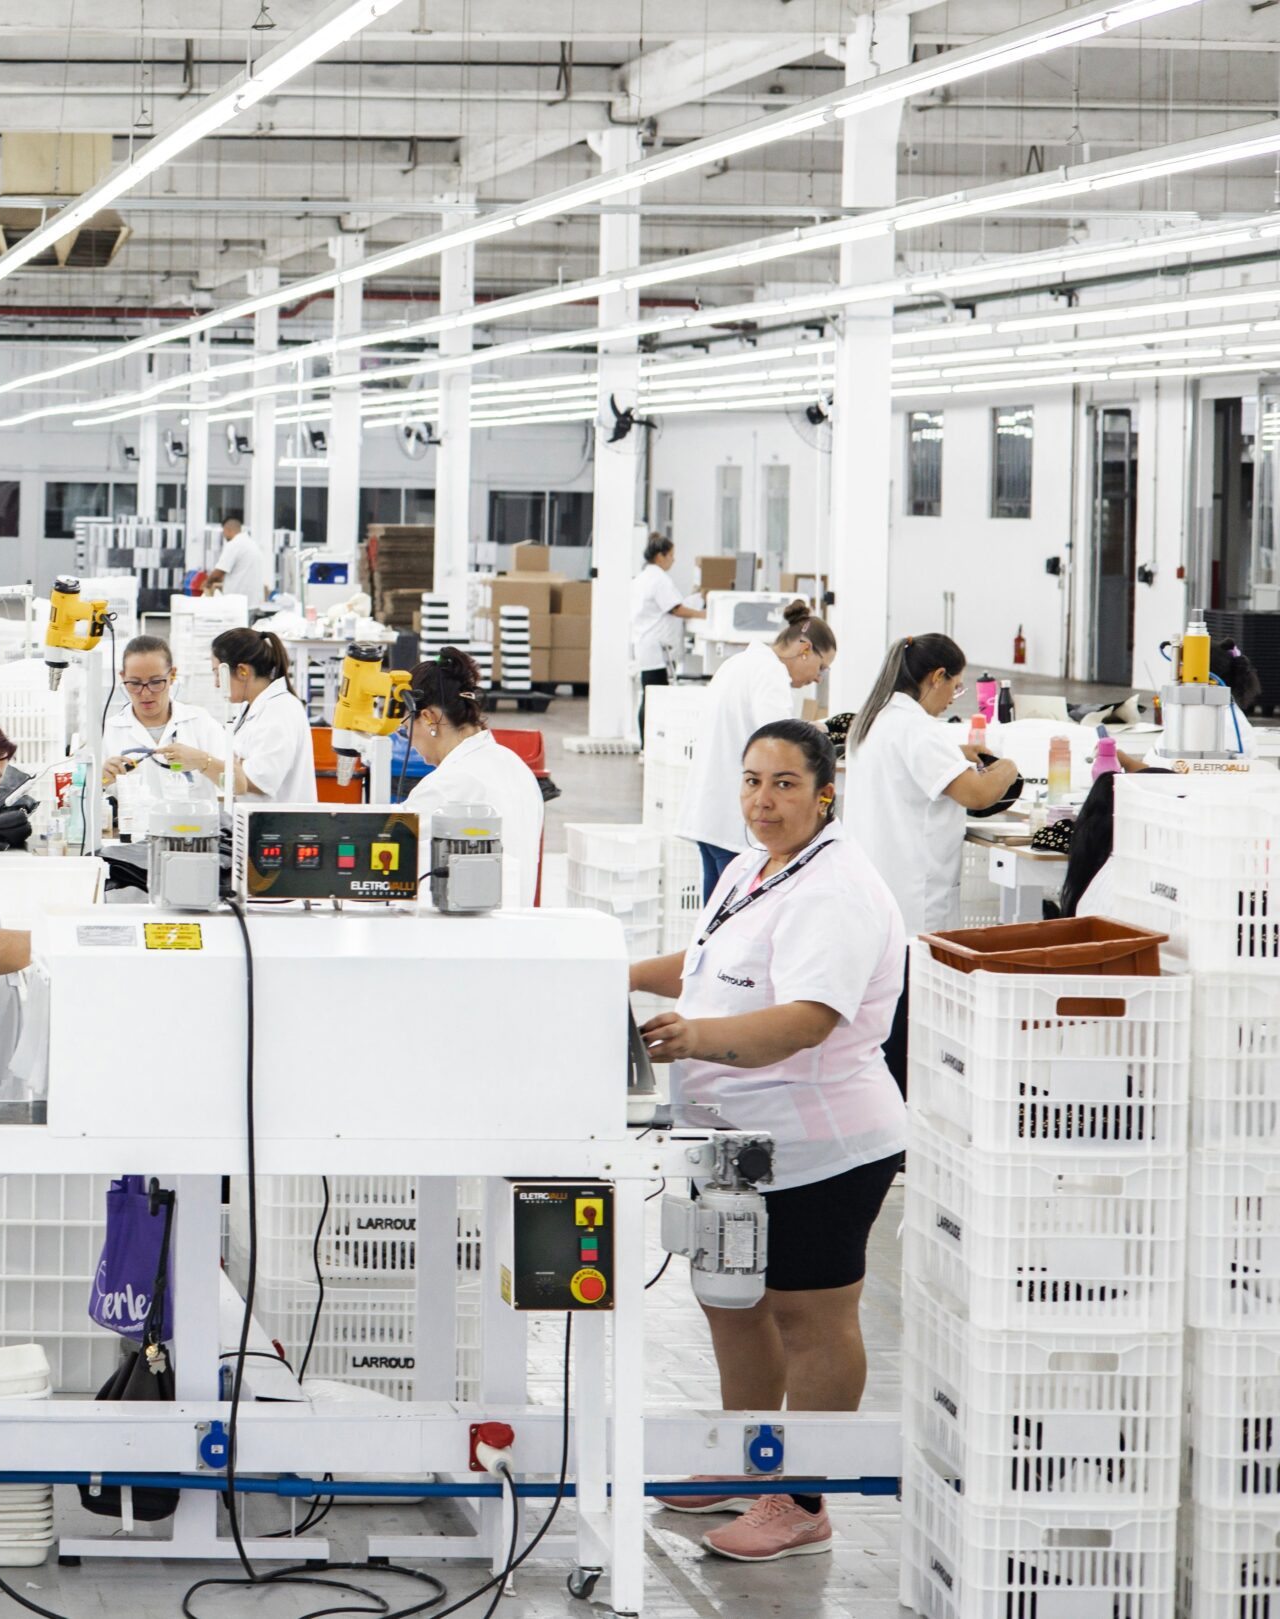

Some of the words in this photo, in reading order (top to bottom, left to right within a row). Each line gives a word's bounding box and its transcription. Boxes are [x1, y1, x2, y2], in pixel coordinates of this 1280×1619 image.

[1193, 763, 1250, 773] ELETROVALLI
[350, 880, 415, 891] ELETROVALLI
[519, 1192, 568, 1200] ELETROVALLI
[357, 1218, 416, 1230] LARROUD
[352, 1356, 415, 1369] LARROUD
